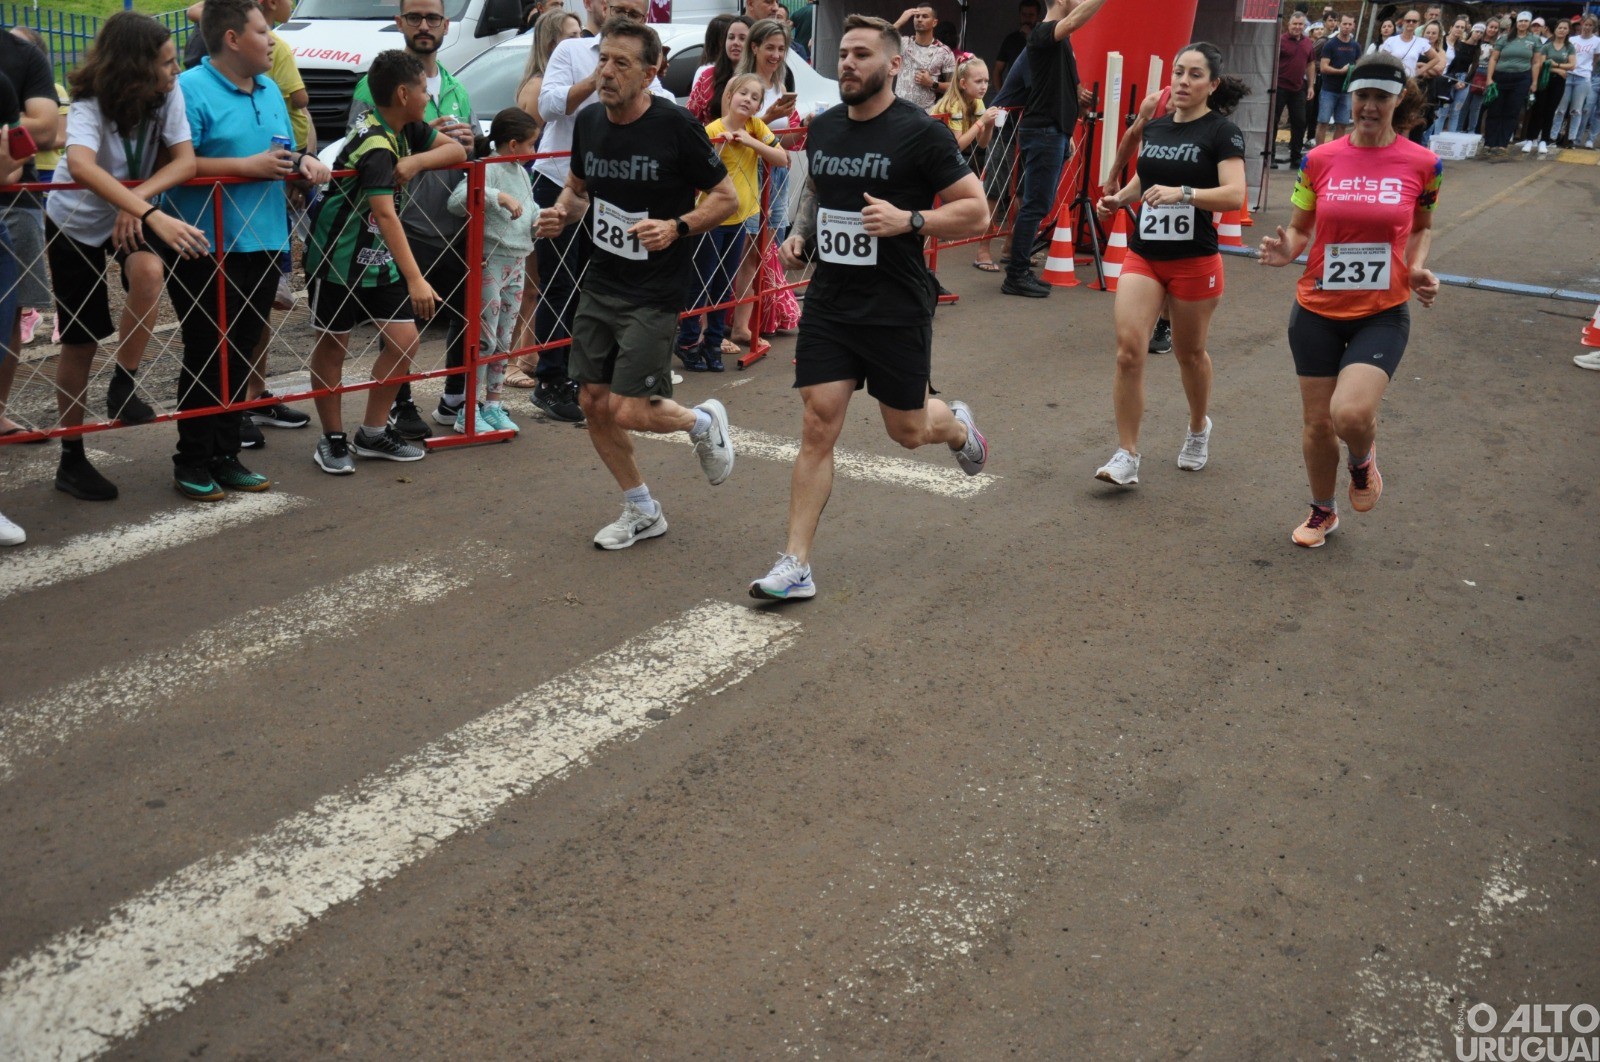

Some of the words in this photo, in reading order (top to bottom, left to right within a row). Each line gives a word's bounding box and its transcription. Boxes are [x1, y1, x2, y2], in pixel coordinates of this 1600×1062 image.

[1140, 141, 1201, 163] rossFit
[584, 151, 660, 181] CrossFit
[811, 149, 892, 180] CrossFit
[1327, 176, 1378, 191] Let's
[1325, 193, 1377, 204] Training
[597, 218, 640, 253] 281
[1143, 214, 1190, 235] 216
[820, 229, 872, 258] 308
[1327, 261, 1386, 283] 237
